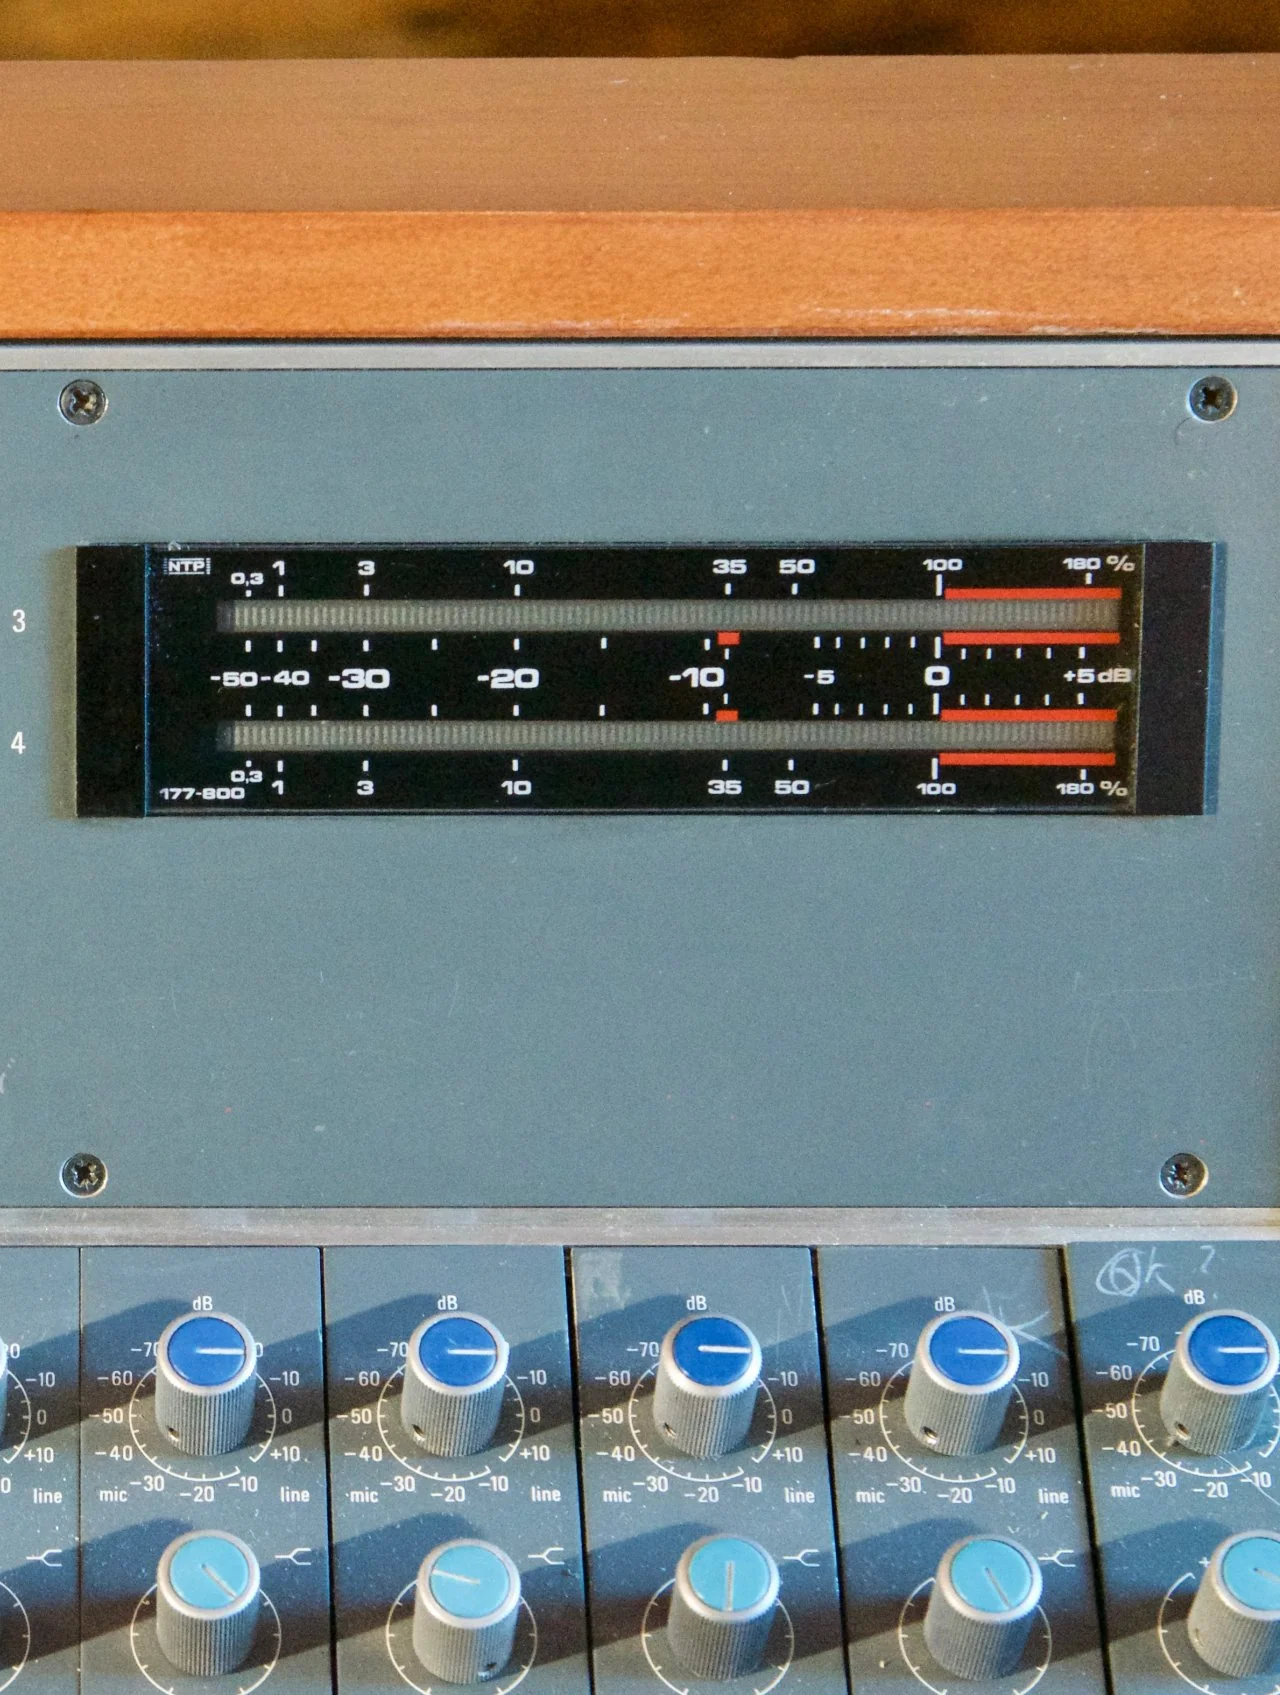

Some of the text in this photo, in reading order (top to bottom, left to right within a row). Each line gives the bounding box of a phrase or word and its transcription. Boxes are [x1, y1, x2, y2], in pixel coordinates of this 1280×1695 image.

[168, 560, 205, 572] NTP
[273, 561, 284, 575] 1
[358, 561, 375, 575] 3
[504, 560, 534, 574] 10
[713, 559, 747, 574] 35
[779, 559, 815, 574] 50
[923, 559, 962, 571] 100
[1063, 558, 1100, 570] 180
[1107, 555, 1135, 571] %
[13, 609, 25, 632] 3
[211, 666, 1131, 689] -50 -40 -30 -20 -10 -5 0 +5 dB
[11, 732, 26, 754] 4
[160, 787, 245, 799] 177-800
[272, 780, 283, 794] 1
[357, 780, 374, 795] 3
[501, 781, 531, 795] 10
[708, 780, 742, 794] 35
[775, 780, 809, 794] 50
[917, 783, 956, 794] 100
[1056, 783, 1094, 794] 180
[1100, 781, 1128, 796] %
[193, 1296, 212, 1310] dB
[438, 1295, 457, 1310] dB
[687, 1295, 706, 1310] dB
[935, 1297, 955, 1311] dB
[1184, 1290, 1205, 1304] dB
[1127, 1336, 1160, 1351] -70
[1096, 1365, 1132, 1380] -60
[89, 1408, 123, 1423] -50
[336, 1408, 372, 1424] -50
[588, 1408, 623, 1424] -50
[839, 1409, 874, 1424] -50
[24, 1447, 54, 1463] +10
[95, 1445, 132, 1461] -40
[270, 1446, 300, 1461] +10
[345, 1446, 382, 1461] -40
[520, 1445, 550, 1461] +10
[596, 1446, 635, 1461] -40
[772, 1447, 803, 1462] +10
[849, 1447, 887, 1462] -40
[1025, 1448, 1056, 1463] +10
[130, 1475, 164, 1491] -30
[380, 1476, 415, 1492] -30
[633, 1476, 668, 1492] -30
[886, 1477, 921, 1492] -30
[1141, 1471, 1176, 1487] -30
[33, 1488, 62, 1503] line
[100, 1491, 127, 1502] mic
[180, 1486, 214, 1502] -20
[281, 1486, 309, 1502] line
[350, 1487, 378, 1502] mic
[431, 1486, 465, 1502] -20
[532, 1486, 561, 1501] line
[603, 1491, 631, 1502] mic
[684, 1487, 719, 1502] -20
[785, 1488, 814, 1503] line
[856, 1488, 885, 1503] mic
[937, 1487, 972, 1503] -20
[1039, 1488, 1069, 1503] line
